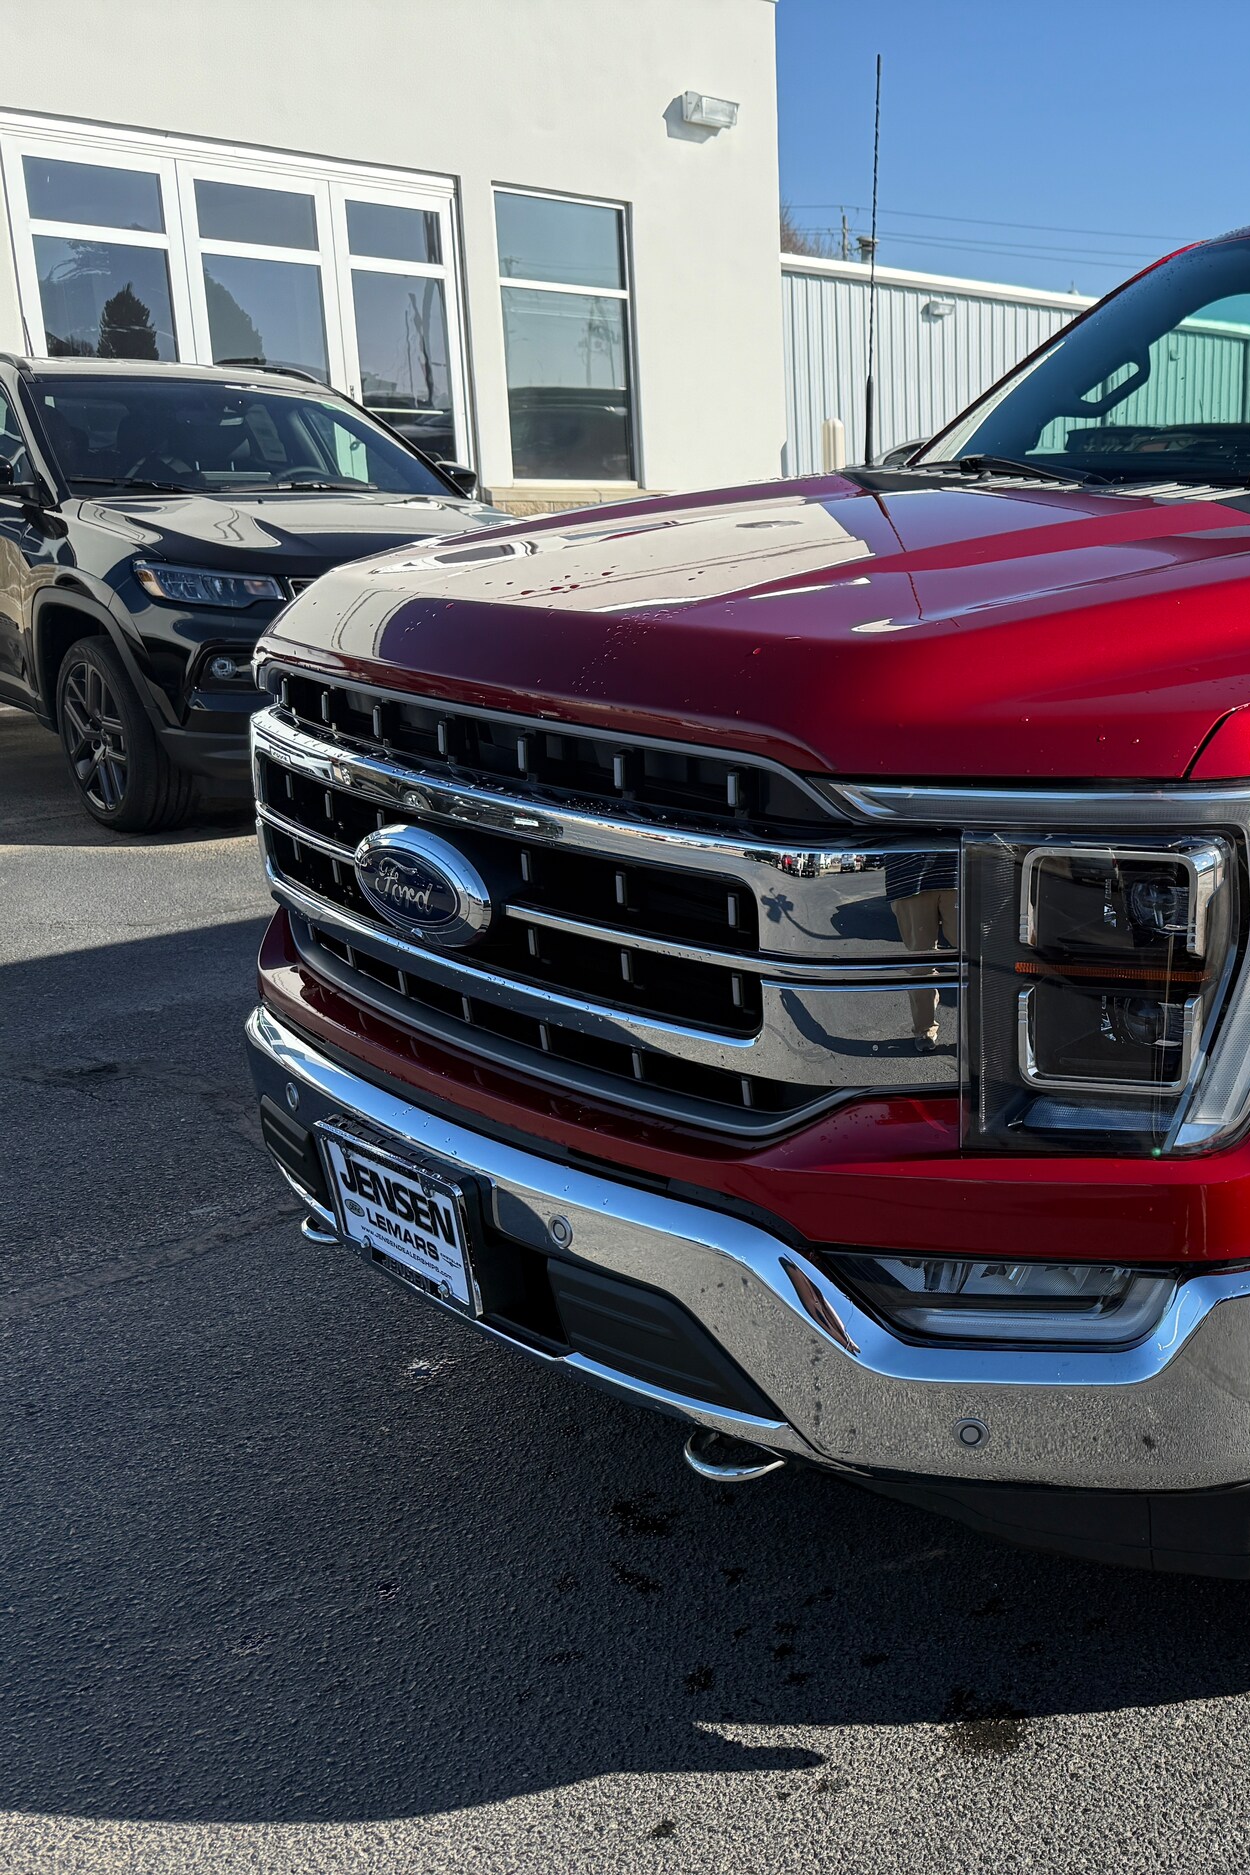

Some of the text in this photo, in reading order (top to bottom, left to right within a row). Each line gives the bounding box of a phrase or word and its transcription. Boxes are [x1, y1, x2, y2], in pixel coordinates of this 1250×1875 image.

[374, 857, 433, 915] Ford
[340, 1157, 456, 1248] JENSEN
[366, 1207, 440, 1261] LEMARS
[381, 1257, 431, 1292] JENSEN
